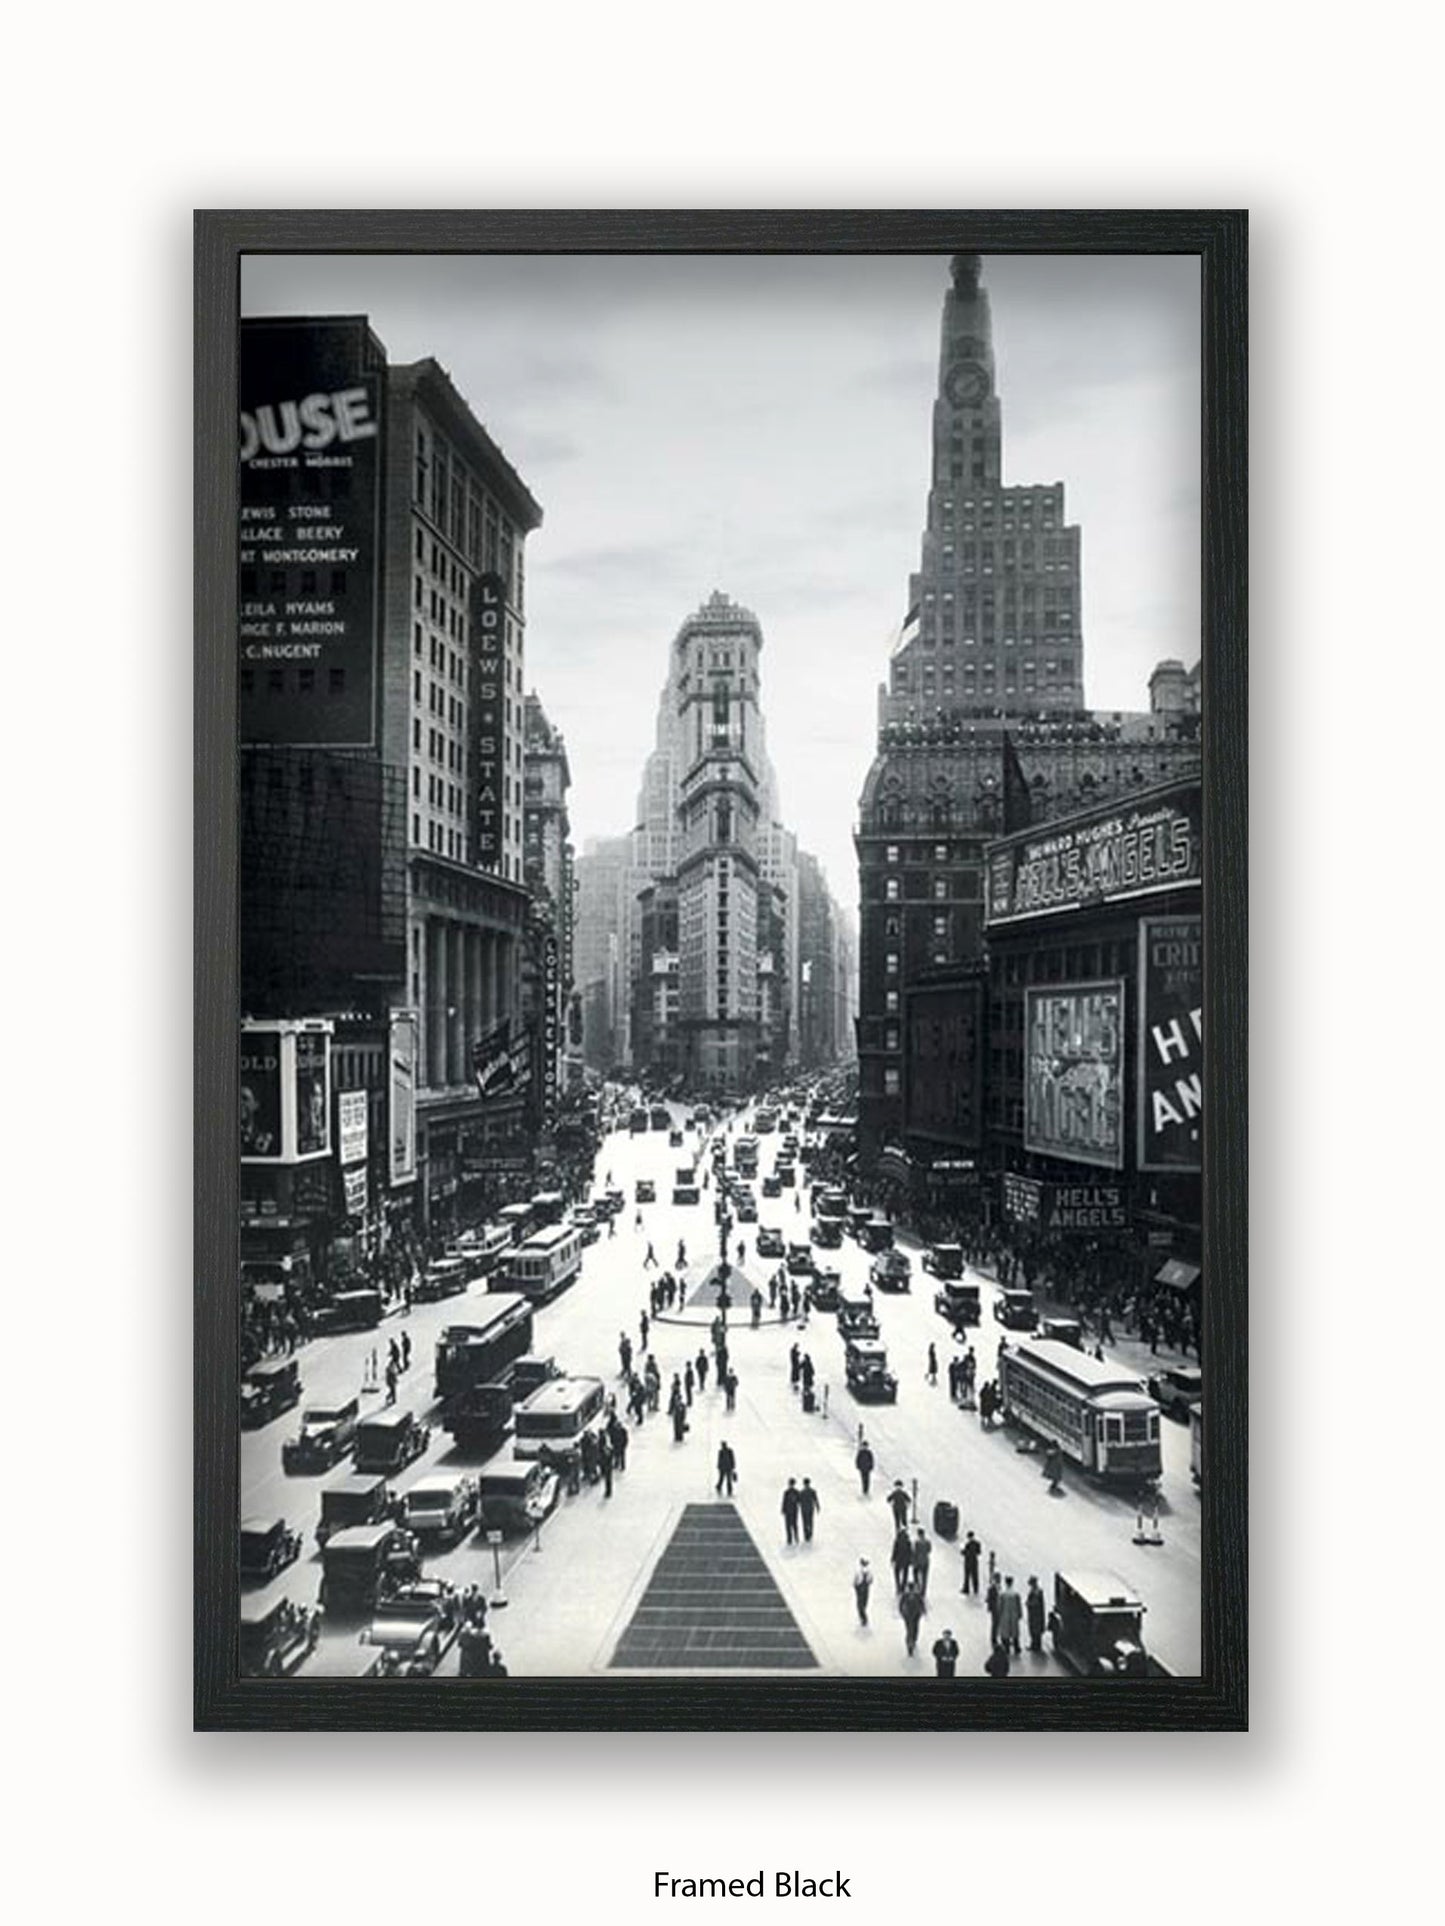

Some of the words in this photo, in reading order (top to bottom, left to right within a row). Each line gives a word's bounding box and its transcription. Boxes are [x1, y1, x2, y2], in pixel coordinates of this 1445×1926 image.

[288, 505, 331, 519] STONE
[296, 525, 344, 541] BEERY
[262, 546, 359, 563] MONTGOMERY
[291, 621, 345, 636] MARION
[479, 586, 498, 700] LOEWS
[479, 736, 497, 850] STATE
[1085, 816, 1188, 893] ANGELS
[1049, 1208, 1126, 1227] ANGELS
